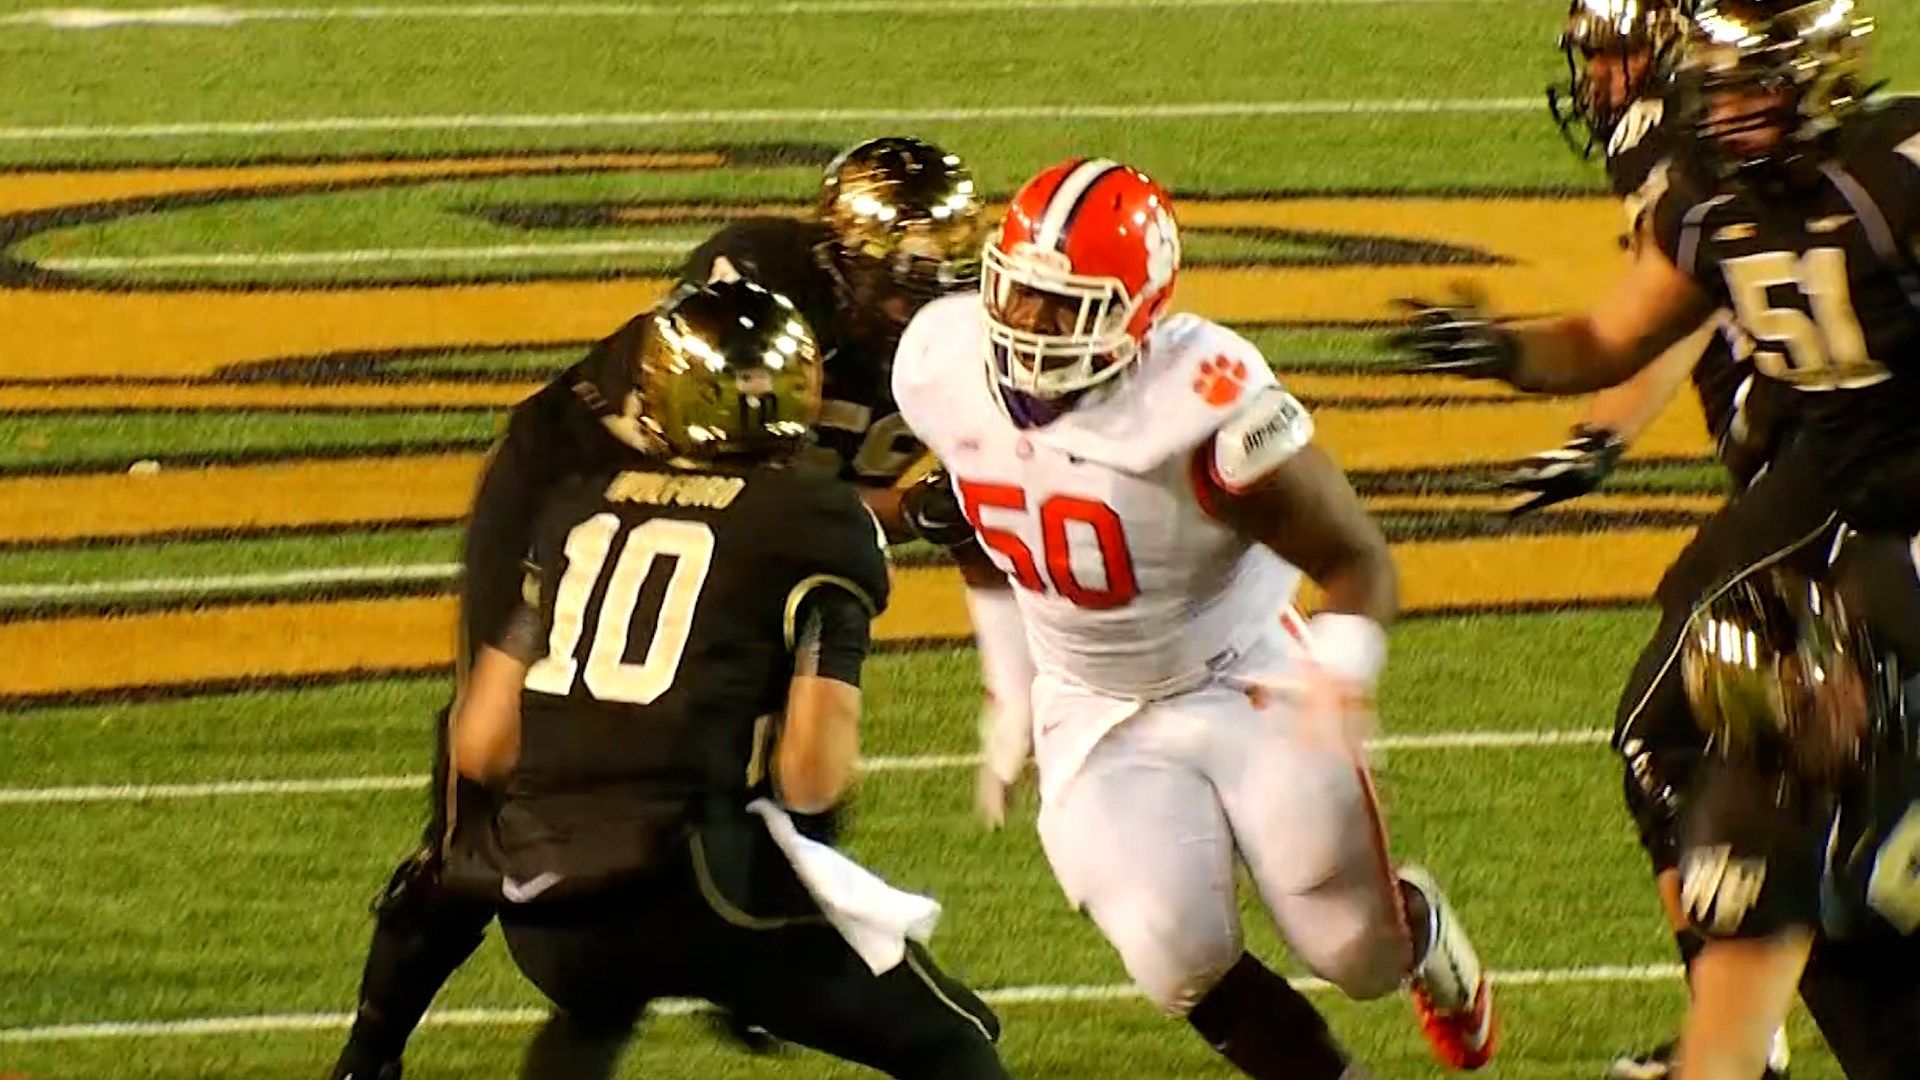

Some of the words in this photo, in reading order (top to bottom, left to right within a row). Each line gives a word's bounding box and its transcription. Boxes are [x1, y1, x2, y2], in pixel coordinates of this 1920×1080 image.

[1719, 248, 1894, 391] 51
[524, 513, 716, 705] 10
[959, 478, 1140, 610] 50
